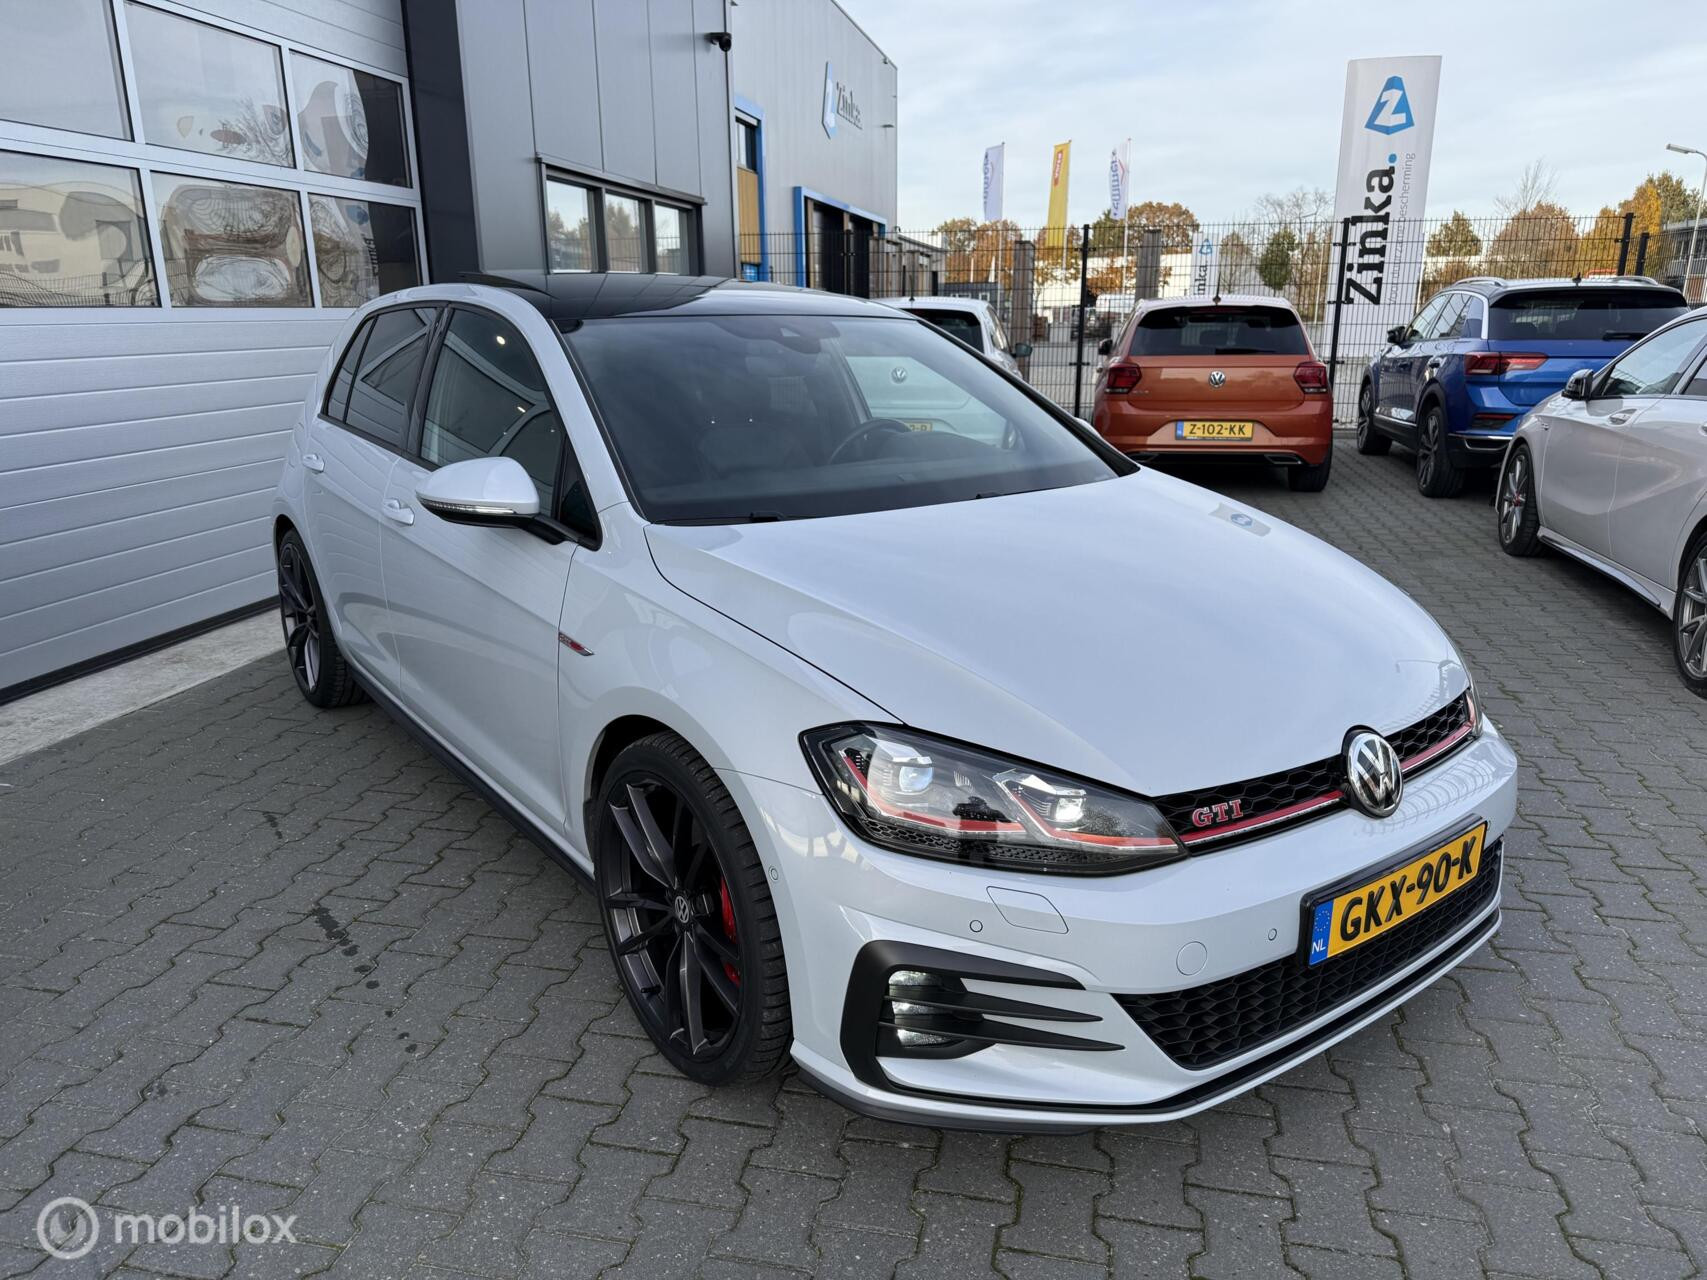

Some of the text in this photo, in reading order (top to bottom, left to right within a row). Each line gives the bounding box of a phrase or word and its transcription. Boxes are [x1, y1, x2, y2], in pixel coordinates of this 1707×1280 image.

[1396, 153, 1416, 223] bescherming
[1189, 423, 1246, 436] Z-102-KK
[1192, 799, 1244, 828] GTI
[1340, 836, 1477, 942] GKX-90-K
[1311, 938, 1326, 955] NL
